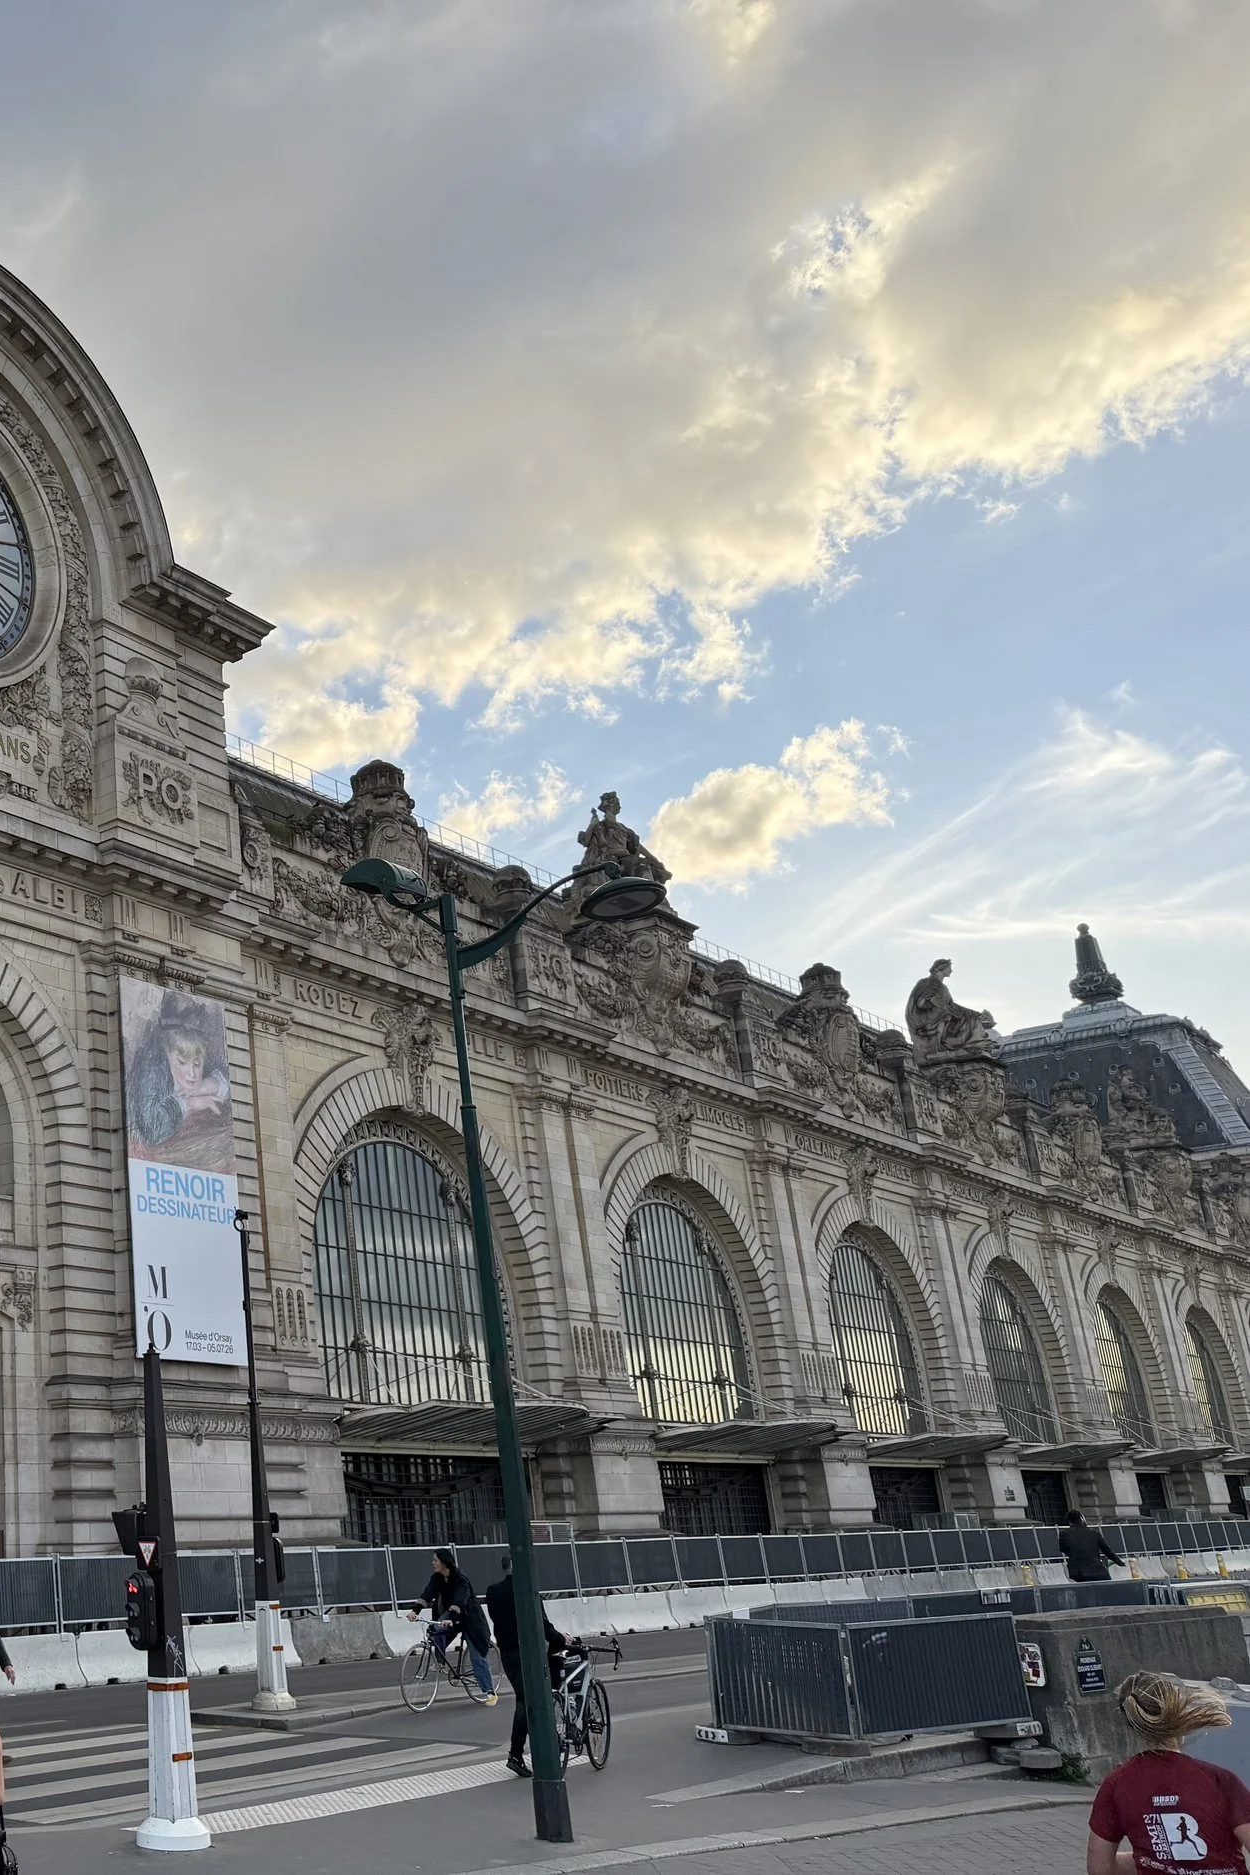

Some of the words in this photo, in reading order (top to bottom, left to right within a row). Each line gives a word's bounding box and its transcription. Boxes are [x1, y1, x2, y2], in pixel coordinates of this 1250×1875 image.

[12, 872, 79, 914] ALBI
[295, 978, 364, 1019] RODEZ
[447, 1026, 506, 1061] TLLE
[584, 1069, 644, 1102] POITIERS
[145, 1166, 226, 1204] RENOIR
[146, 1263, 169, 1300] M
[185, 1329, 208, 1341] Musée
[208, 1332, 233, 1345] d'Orsay
[1146, 1824, 1167, 1860] SEMI
